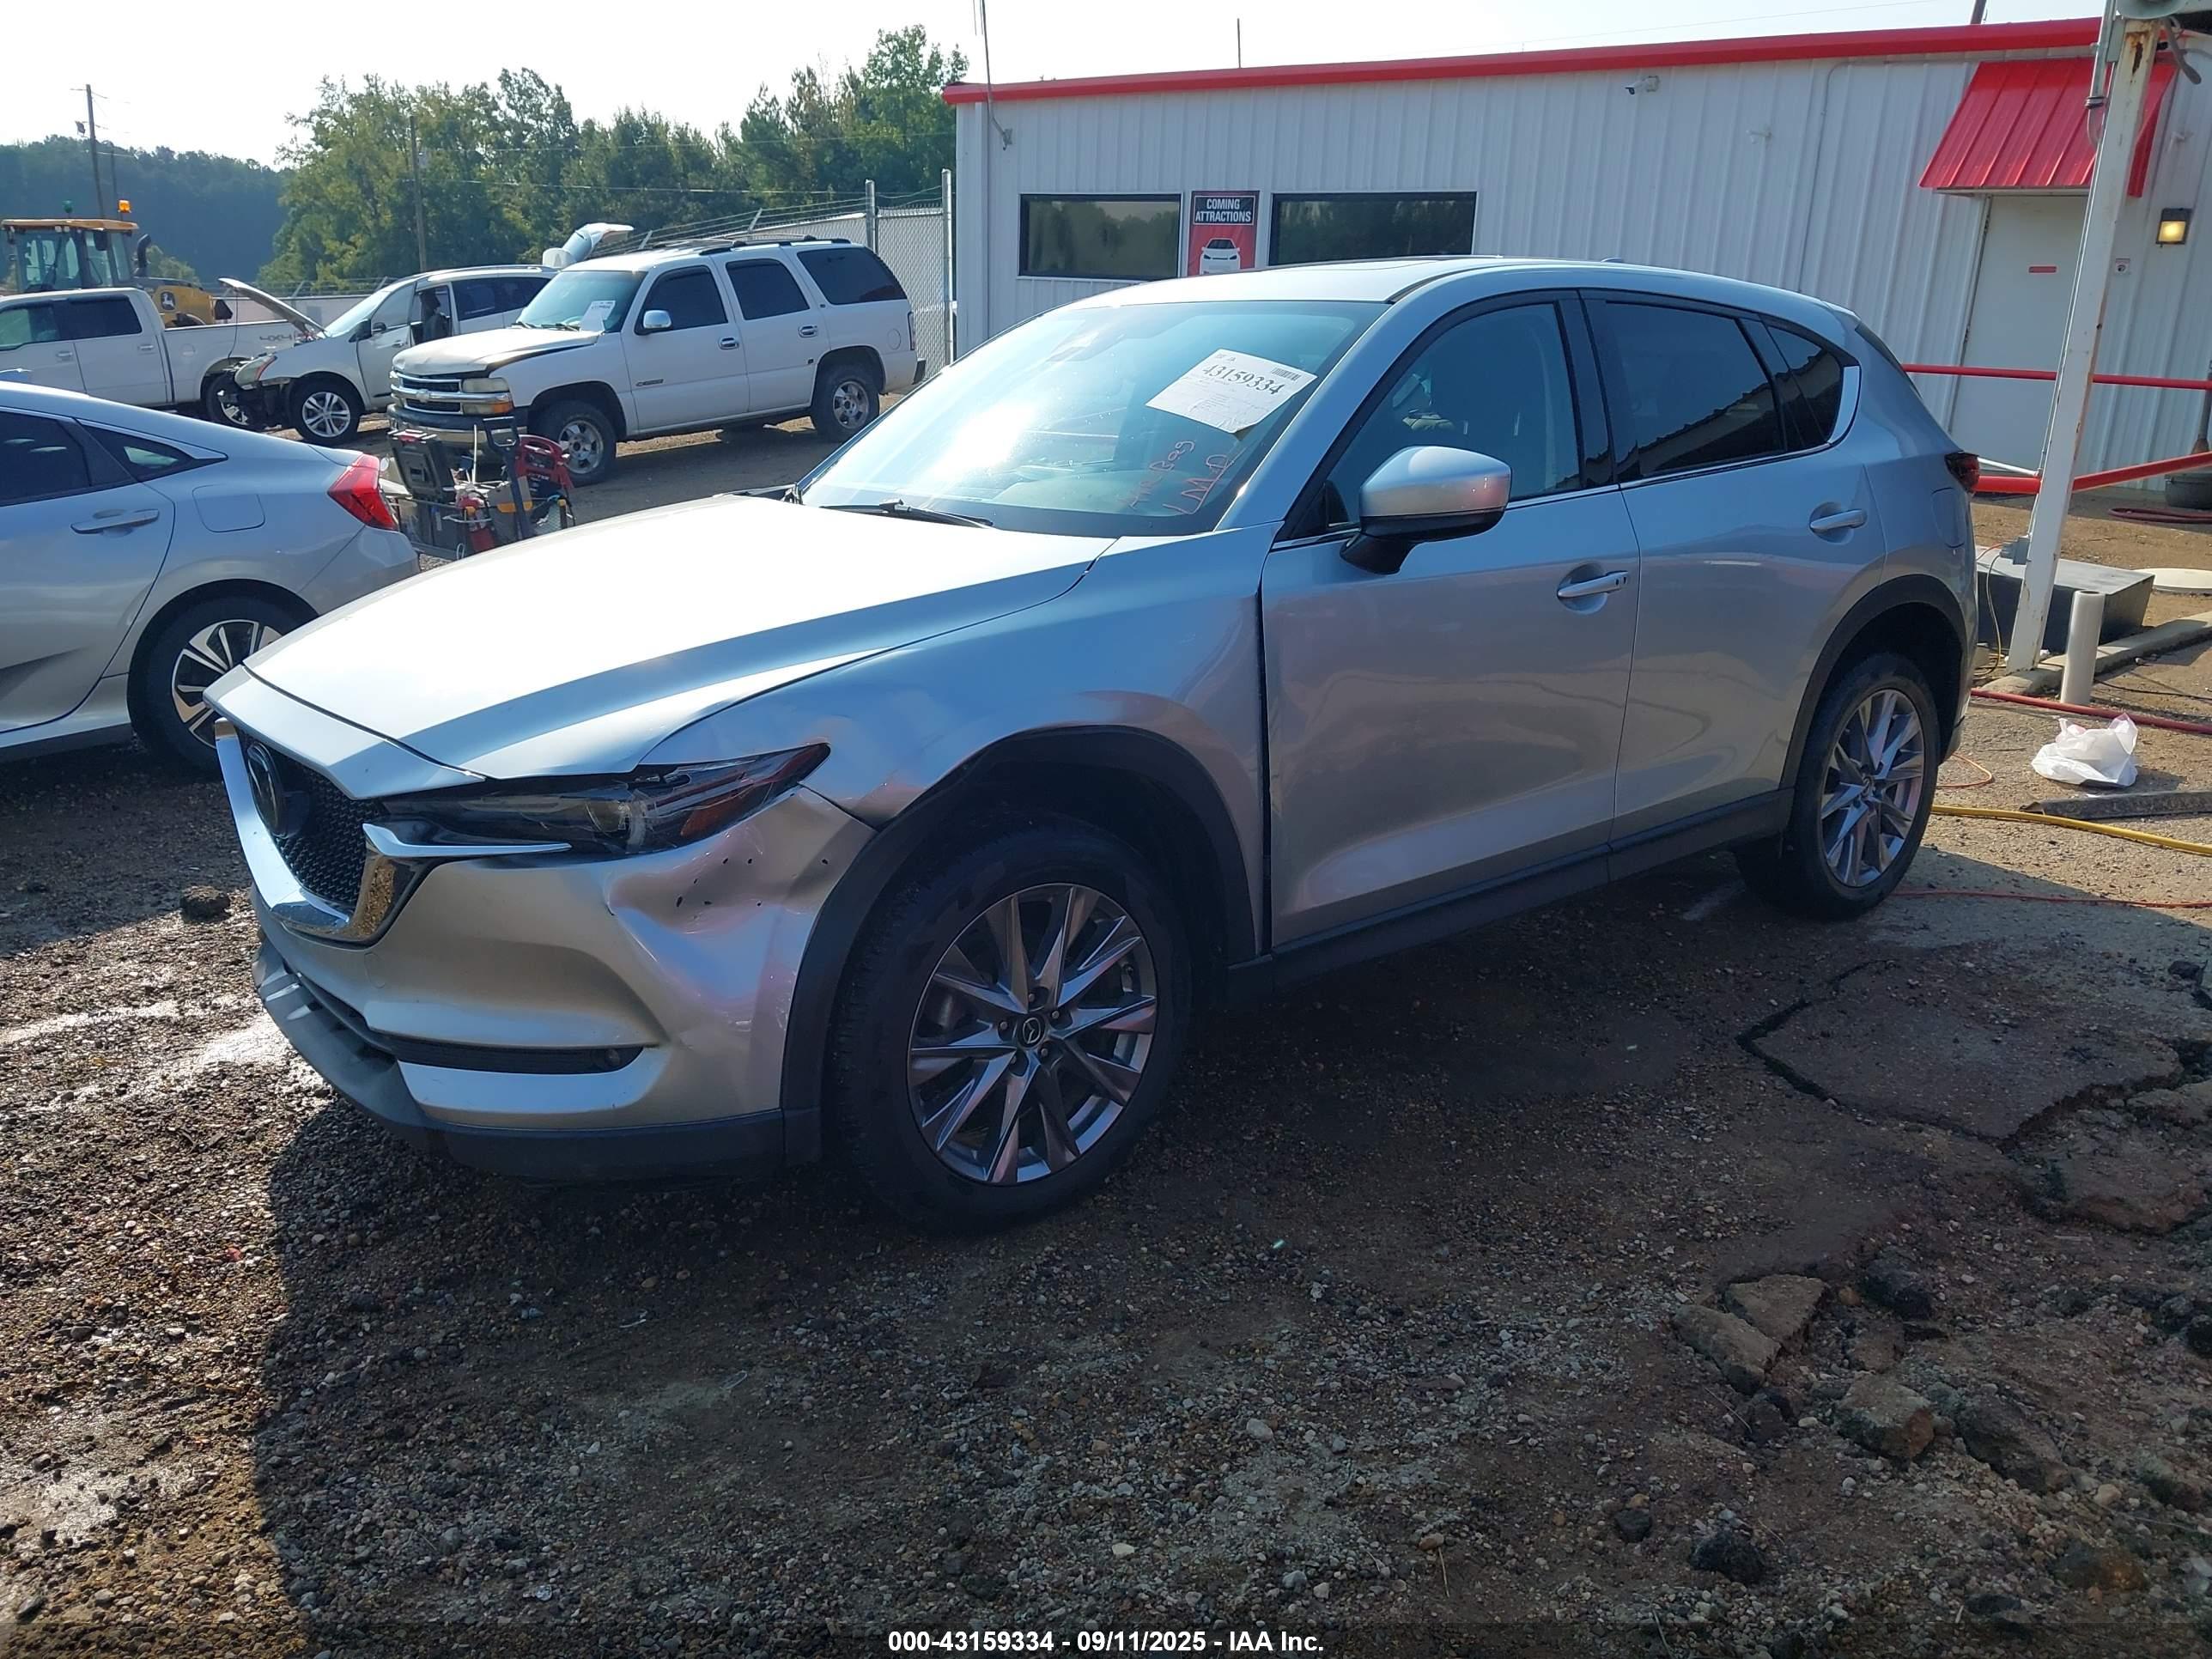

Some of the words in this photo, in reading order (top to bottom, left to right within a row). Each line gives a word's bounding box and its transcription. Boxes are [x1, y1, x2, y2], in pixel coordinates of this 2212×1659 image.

[1206, 198, 1240, 210] COMING
[1194, 210, 1251, 222] ATTRACTIONS
[1202, 364, 1285, 395] 43159334
